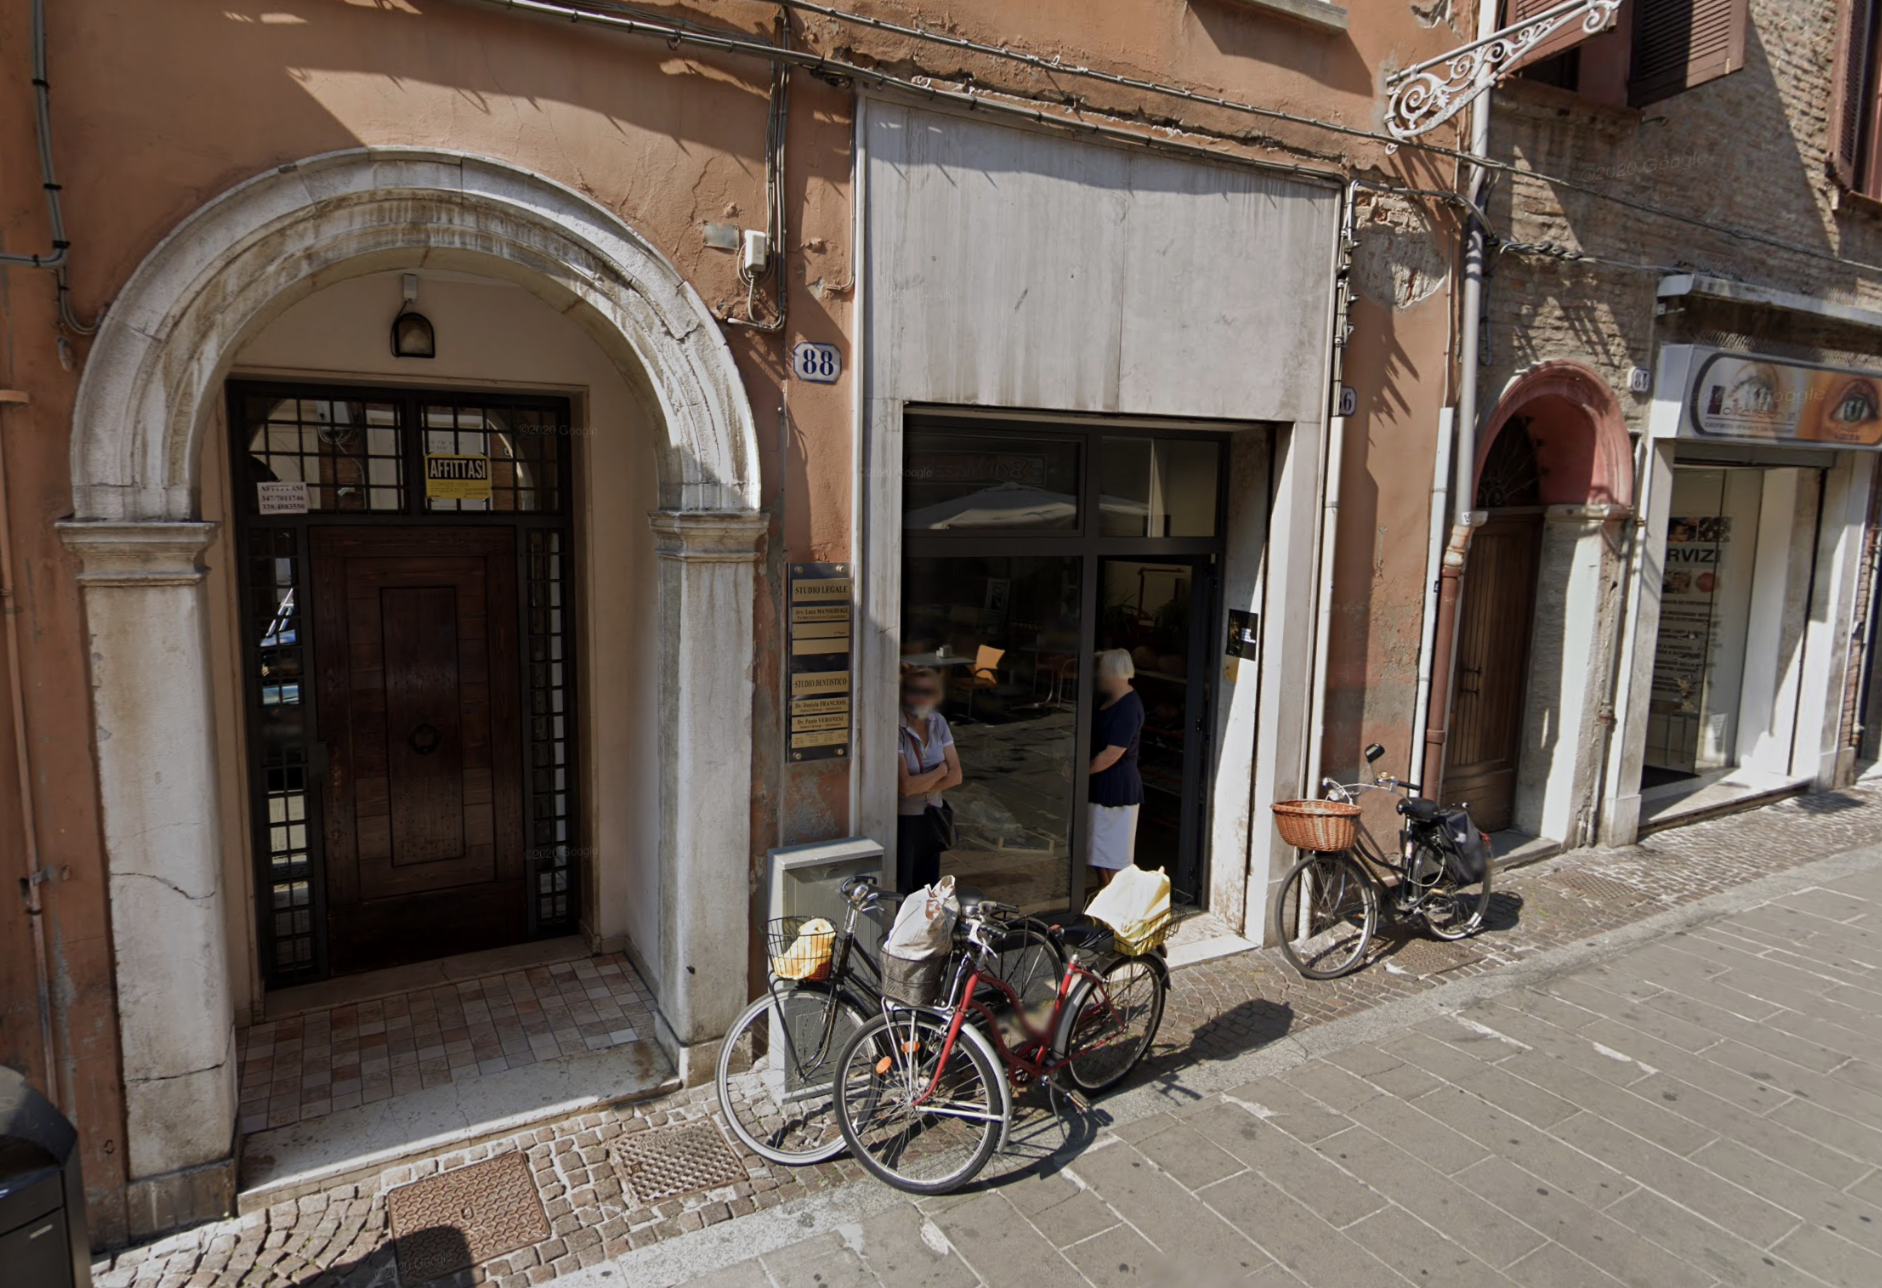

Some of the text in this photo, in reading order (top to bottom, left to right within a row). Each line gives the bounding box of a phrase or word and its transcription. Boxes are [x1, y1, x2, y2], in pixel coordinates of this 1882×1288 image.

[803, 349, 834, 376] 88
[429, 459, 486, 478] AFFITTASI
[1667, 548, 1722, 563] RVIZI
[795, 585, 848, 594] STUDIO LEGALE
[794, 677, 847, 688] STUDIO DENTISTICO
